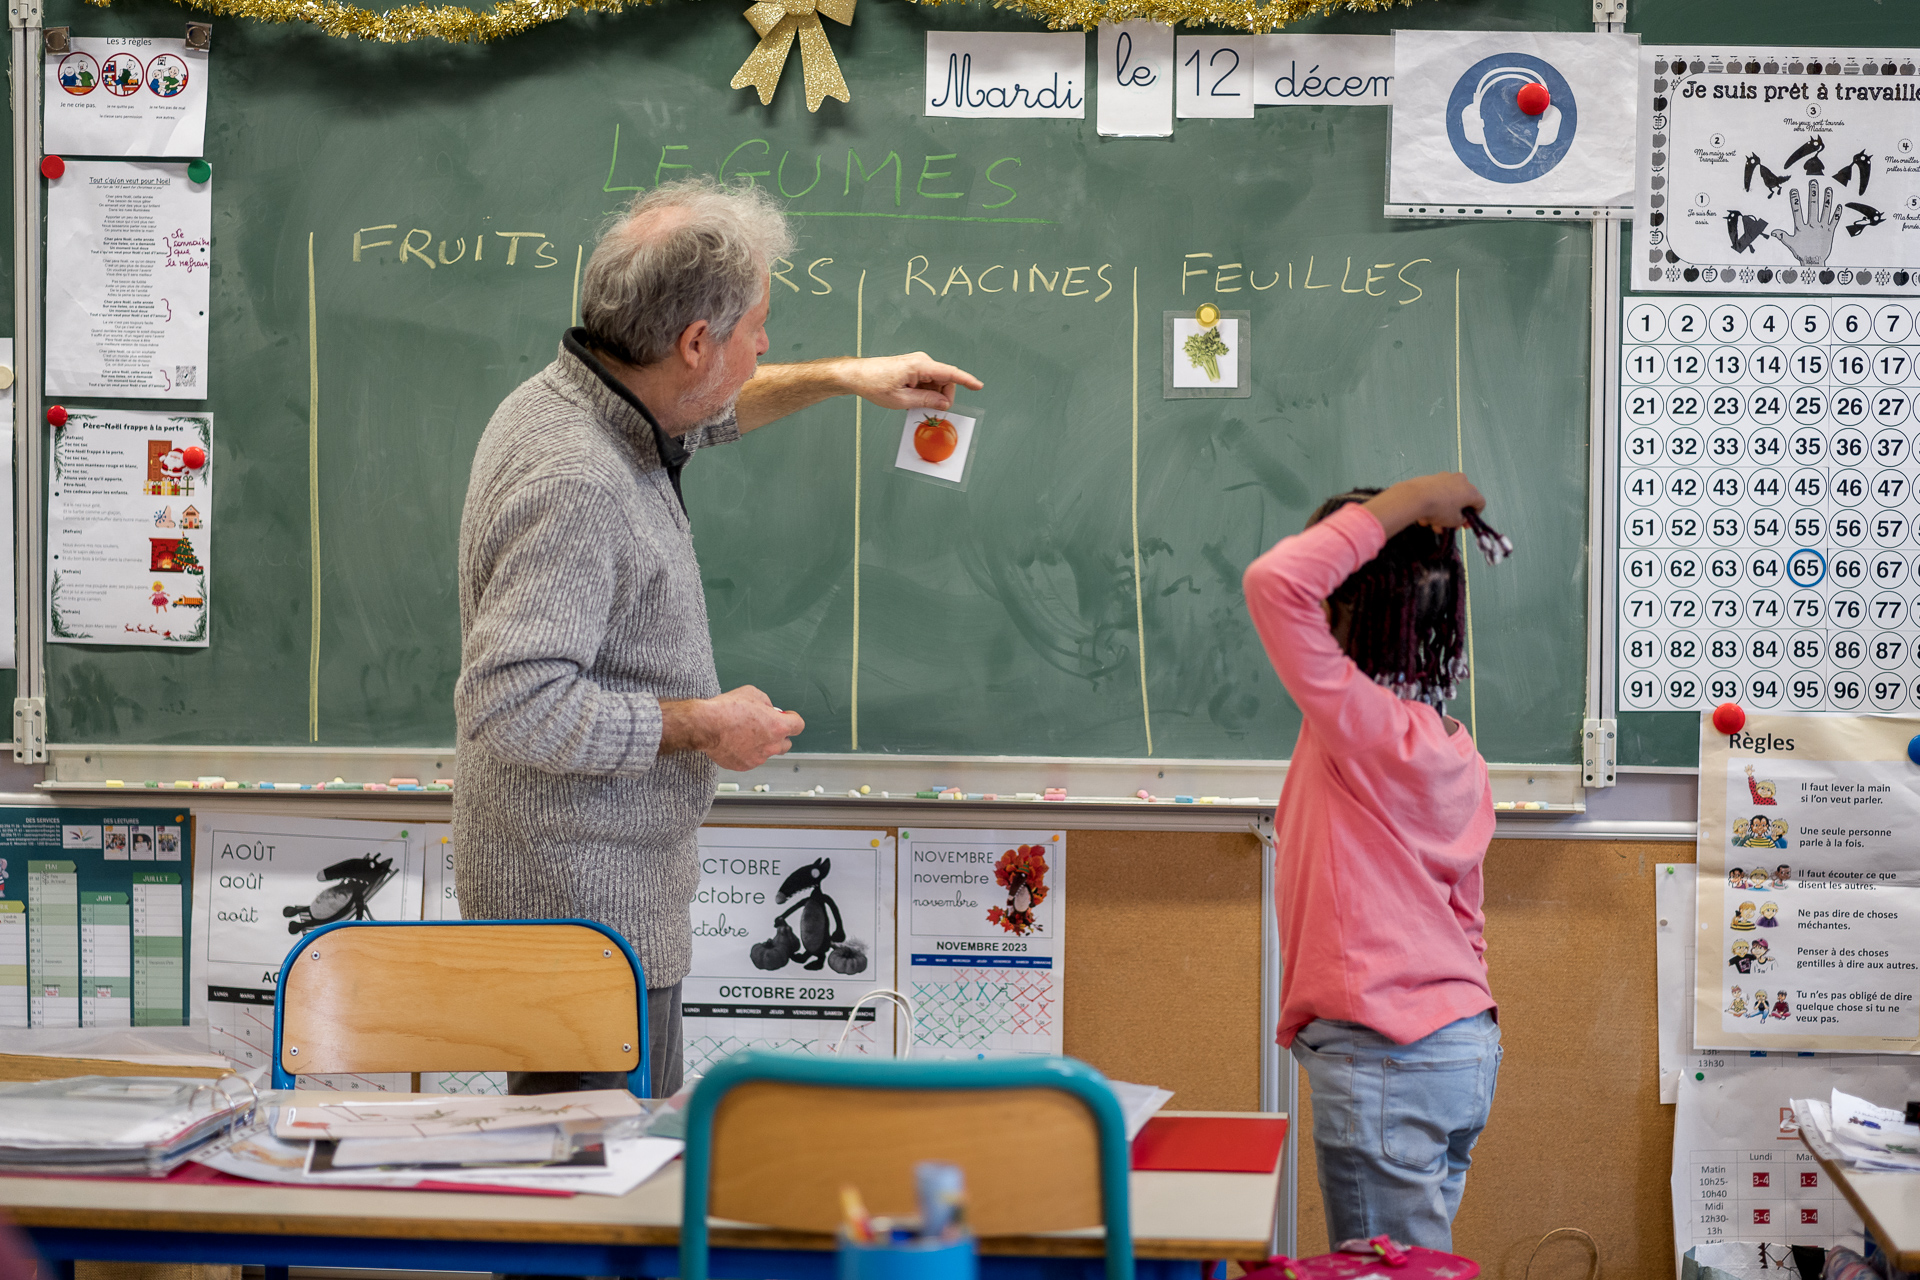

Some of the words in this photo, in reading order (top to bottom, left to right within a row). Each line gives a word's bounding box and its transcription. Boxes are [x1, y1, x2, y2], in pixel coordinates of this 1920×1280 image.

[107, 37, 119, 45] Les
[128, 38, 152, 47] règles
[931, 52, 1084, 109] Mardi
[1115, 31, 1157, 88] le
[1184, 47, 1241, 97] 12
[1682, 80, 1707, 99] Je
[1712, 81, 1757, 100] suis
[1764, 82, 1810, 102] prêt
[1816, 83, 1828, 100] à
[1902, 142, 1909, 150] 4
[1694, 148, 1709, 156] Mes
[1709, 150, 1724, 158] mains
[1725, 149, 1736, 157] sont
[603, 122, 1022, 210] LEGUMES
[1700, 195, 1704, 203] 1
[1688, 209, 1695, 217] Je
[1706, 209, 1717, 217] bien
[352, 223, 559, 270] FRUITS
[174, 249, 191, 257] que
[165, 258, 176, 268] le
[905, 254, 1112, 302] RACINES
[1182, 252, 1432, 305] FEUILLES
[1641, 314, 1650, 332] 1
[1681, 315, 1694, 332] 2
[1722, 315, 1735, 333] 3
[1762, 315, 1776, 333] 4
[1804, 315, 1817, 333] 5
[1845, 315, 1858, 333] 6
[1887, 315, 1900, 332] 7
[82, 422, 122, 430] Père-Noël
[124, 424, 148, 432] frappe
[150, 423, 154, 431] à
[164, 424, 183, 432] porte
[1632, 437, 1654, 455] 31
[1671, 437, 1697, 455] 32
[1713, 437, 1739, 455] 33
[1754, 437, 1780, 455] 34
[1795, 437, 1821, 455] 35
[1836, 438, 1862, 456] 36
[1877, 438, 1904, 457] 37
[1631, 560, 1653, 578] 61
[1670, 560, 1696, 577] 62
[1711, 559, 1737, 577] 63
[1752, 559, 1778, 577] 64
[1793, 559, 1819, 578] 65
[1835, 560, 1861, 578] 66
[1876, 560, 1903, 579] 67
[1729, 731, 1795, 754] Règles
[1801, 782, 1807, 791] Il
[1810, 783, 1828, 792] faut
[1832, 783, 1854, 792] lever
[1856, 784, 1865, 792] la
[1868, 784, 1891, 792] main
[1801, 795, 1808, 803] si
[1830, 796, 1851, 804] veut
[1854, 796, 1883, 805] parler.
[1800, 827, 1819, 835] Une
[1821, 827, 1846, 836] seule
[1848, 829, 1892, 837] personne
[1800, 838, 1823, 848] parle
[1826, 839, 1831, 847] à
[1834, 839, 1842, 847] la
[1845, 839, 1865, 848] fois.
[221, 840, 276, 862] AOÛT
[914, 851, 994, 864] NOVEMBRE
[699, 858, 781, 875] CTOBRE
[914, 870, 989, 884] novembre
[1798, 870, 1804, 878] Il
[1807, 870, 1825, 878] faut
[1828, 870, 1864, 879] écouter
[1866, 872, 1876, 880] ce
[1879, 872, 1896, 881] que
[219, 873, 264, 890] août
[1798, 880, 1827, 889] disent
[1829, 881, 1842, 890] les
[1844, 882, 1876, 890] autres.
[913, 890, 978, 908] novembre
[217, 906, 258, 923] août
[1798, 909, 1811, 917] Ne
[1813, 910, 1829, 919] pas
[1832, 910, 1850, 918] dire
[1853, 910, 1864, 919] de
[1867, 910, 1898, 919] choses
[692, 913, 749, 937] ctobre
[1798, 921, 1851, 930] méchantes.
[936, 941, 999, 952] NOVEMBRE
[1002, 943, 1028, 952] 2023
[1797, 947, 1828, 956] Penser
[1831, 947, 1836, 956] à
[1839, 948, 1855, 957] des
[1858, 948, 1889, 957] choses
[1796, 959, 1836, 969] gentilles
[1838, 960, 1844, 968] à
[1846, 960, 1865, 969] dire
[1886, 962, 1918, 970] autres.
[719, 985, 795, 999] OCTOBRE
[799, 987, 835, 1000] 2023
[1796, 990, 1807, 999] Tu
[1831, 992, 1846, 1001] pas
[1849, 991, 1877, 1002] obligé
[1880, 992, 1892, 1001] de
[1894, 992, 1912, 1001] dire
[1796, 1002, 1834, 1012] quelque
[1836, 1003, 1863, 1012] chose
[1866, 1004, 1873, 1012] si
[1820, 1016, 1839, 1024] pas.
[1698, 1060, 1724, 1068] 13h30
[1749, 1153, 1772, 1161] Lundi
[1796, 1153, 1816, 1161] Mar
[1701, 1166, 1726, 1174] Matin
[1700, 1178, 1728, 1186] 10h25-
[1753, 1175, 1769, 1185] 3-4
[1801, 1175, 1817, 1185] 1-2
[1701, 1190, 1727, 1198] 10h40
[1705, 1202, 1724, 1211] Midi
[1700, 1215, 1729, 1223] 12h30-
[1754, 1212, 1770, 1222] 5-6
[1801, 1212, 1818, 1222] 3-4
[1707, 1227, 1722, 1235] 13h
